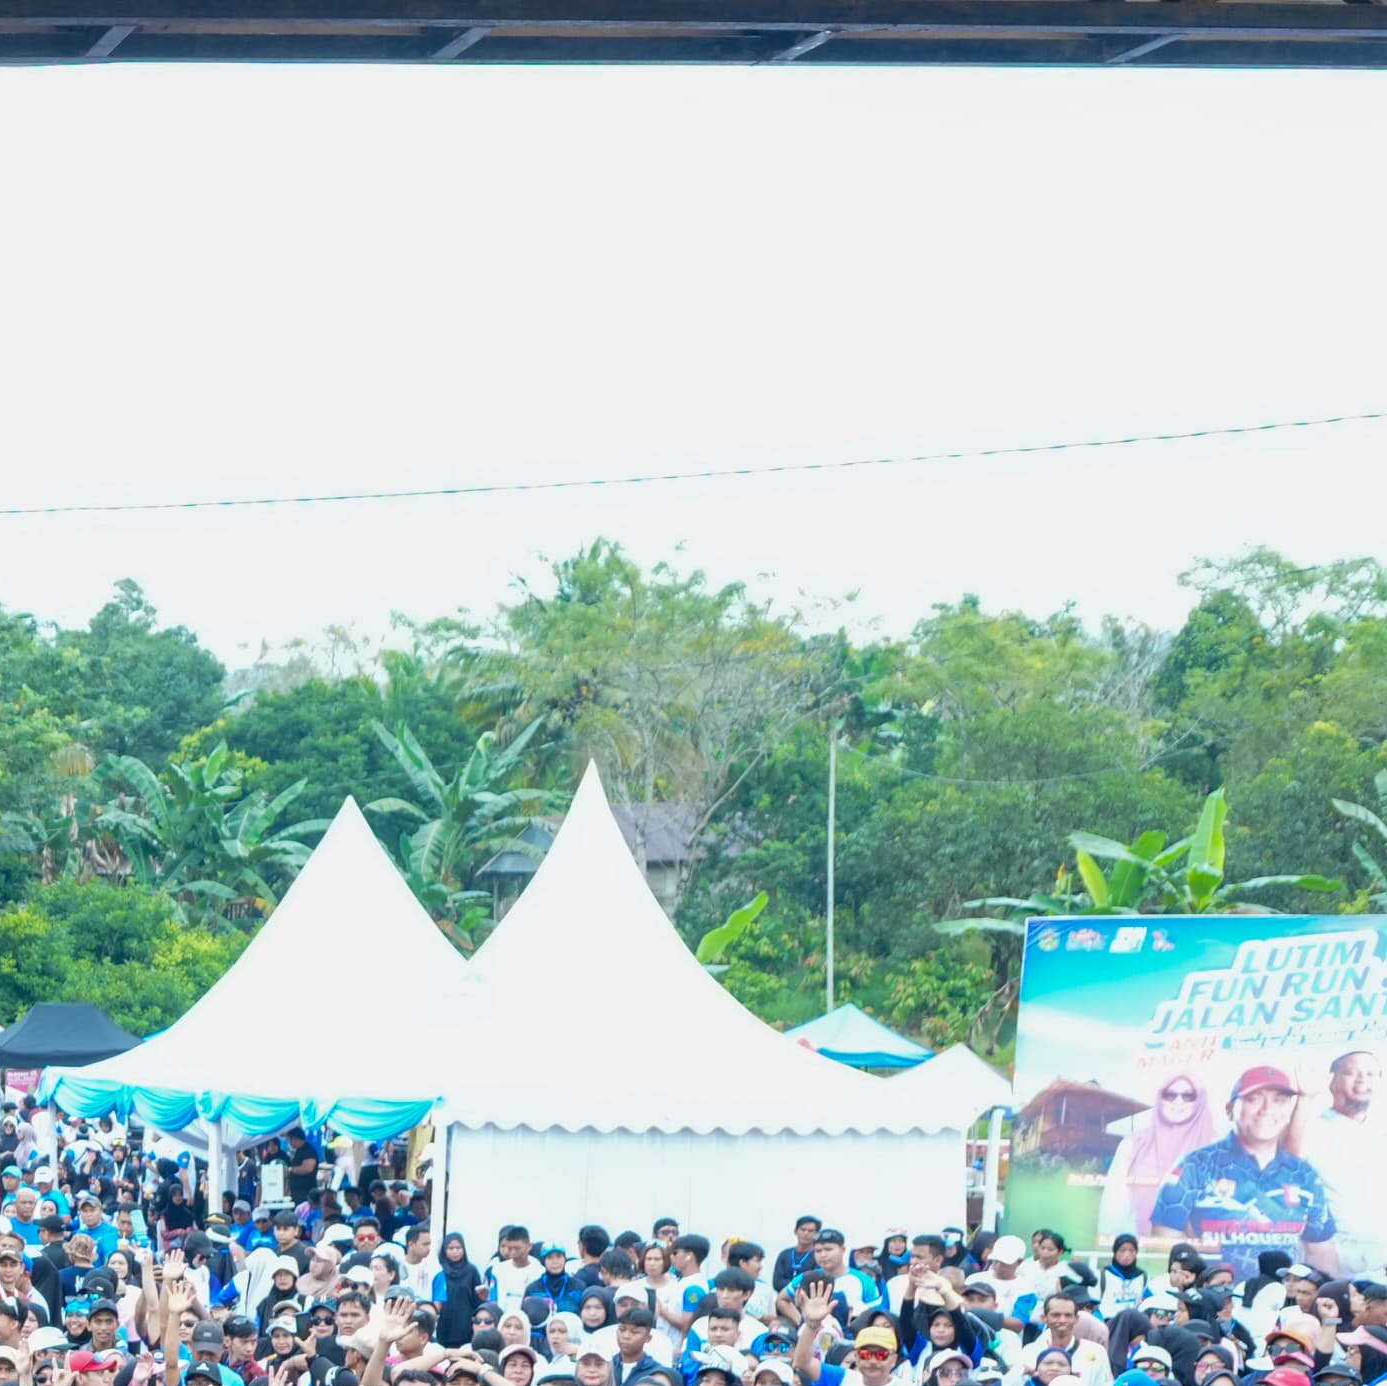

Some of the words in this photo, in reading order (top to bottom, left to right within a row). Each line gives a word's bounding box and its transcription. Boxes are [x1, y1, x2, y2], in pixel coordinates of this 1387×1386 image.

[1241, 939, 1367, 973] LUTIM
[1186, 975, 1268, 1004] FUN
[1279, 967, 1370, 997] RUN
[1152, 1000, 1280, 1034] JALAN
